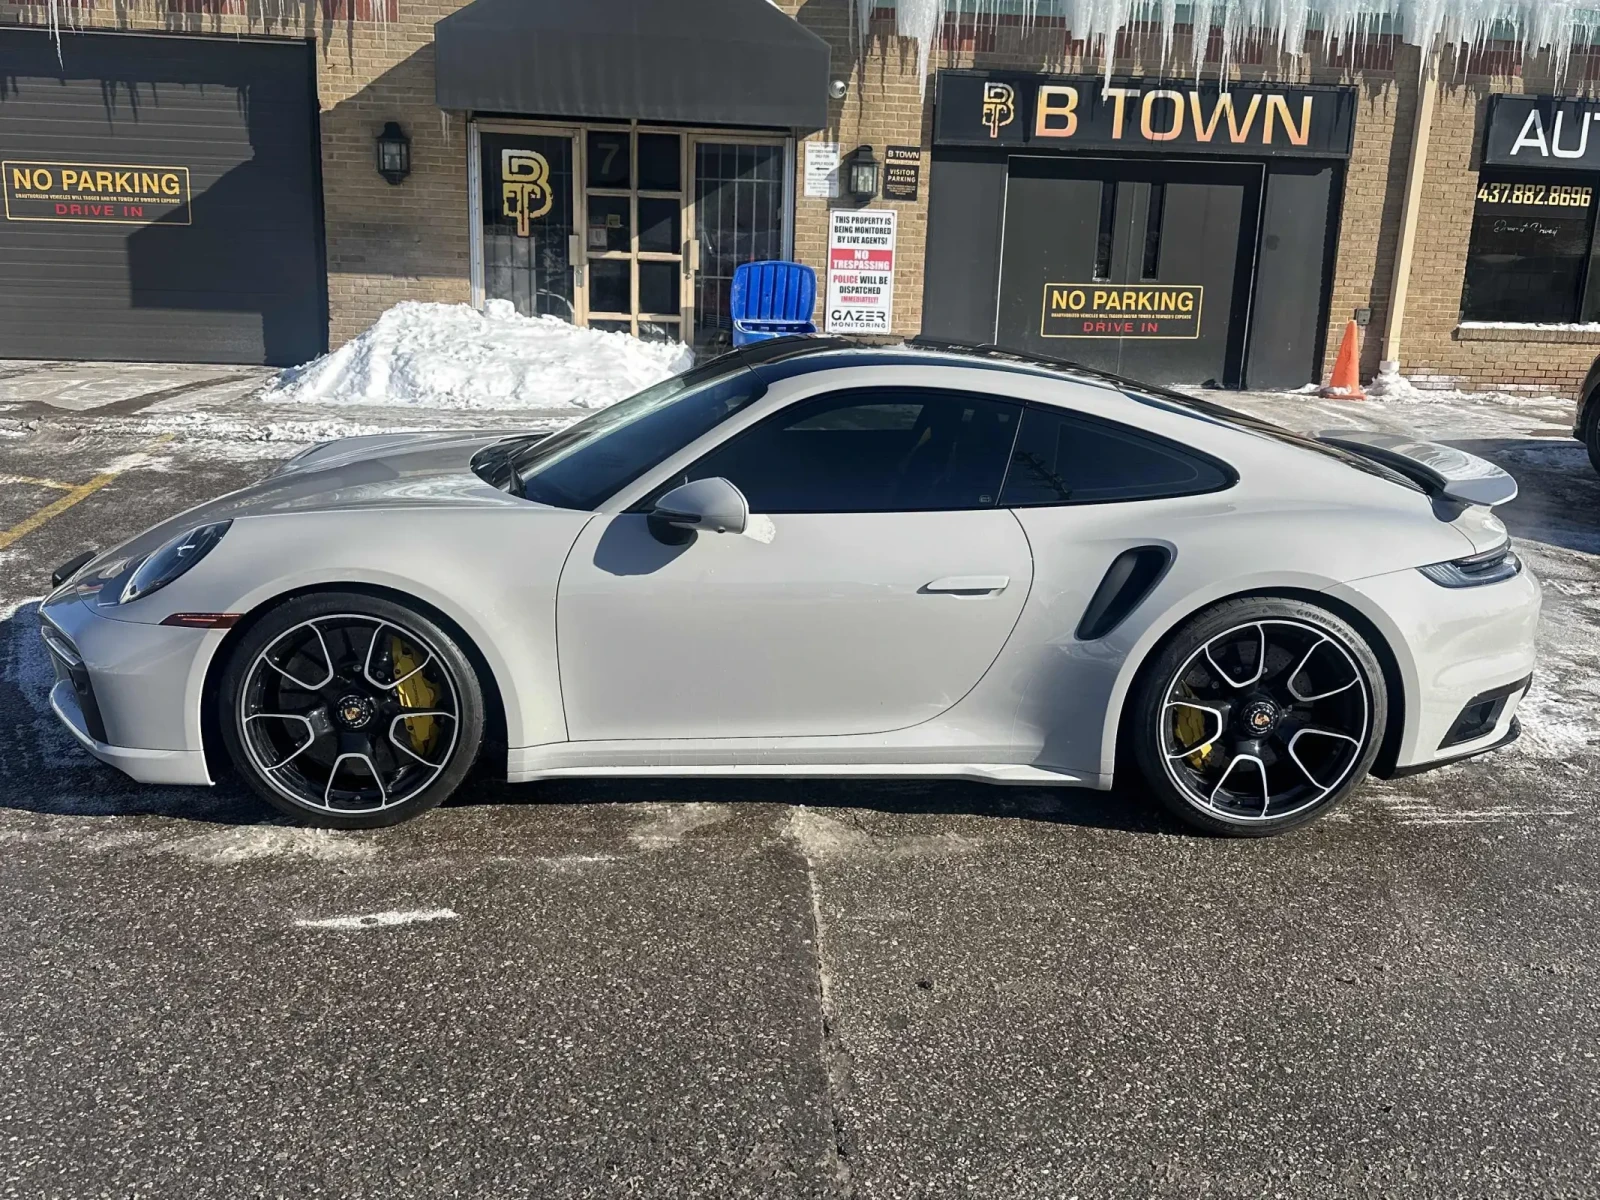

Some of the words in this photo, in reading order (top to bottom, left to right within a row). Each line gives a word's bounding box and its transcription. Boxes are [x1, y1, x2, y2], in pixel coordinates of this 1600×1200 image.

[1036, 86, 1078, 137] B
[1103, 88, 1313, 145] TOWN
[1510, 109, 1600, 158] AU
[597, 144, 620, 174] 7
[13, 168, 53, 190] NO
[62, 170, 180, 194] PARKING
[1477, 182, 1592, 207] 437.882.8696
[54, 203, 114, 216] DRIVE
[124, 206, 143, 217] IN
[835, 216, 851, 224] THIS
[852, 216, 884, 225] PROPERTY
[854, 227, 891, 235] MONITORED
[861, 236, 888, 245] AGENTS!
[854, 250, 869, 260] NO
[833, 260, 890, 270] TRESPASSING
[833, 276, 858, 284] POLICE
[860, 276, 877, 284] WILL
[878, 276, 888, 284] BE
[839, 285, 881, 294] DISPATCHED
[841, 296, 878, 304] IMMEDIATELY!
[1052, 290, 1086, 310] NO
[1093, 291, 1193, 311] PARKING
[831, 310, 886, 321] GAZER
[1083, 322, 1133, 332] DRIVE
[1141, 323, 1158, 332] IN
[1296, 609, 1356, 644] GOODYEAR
